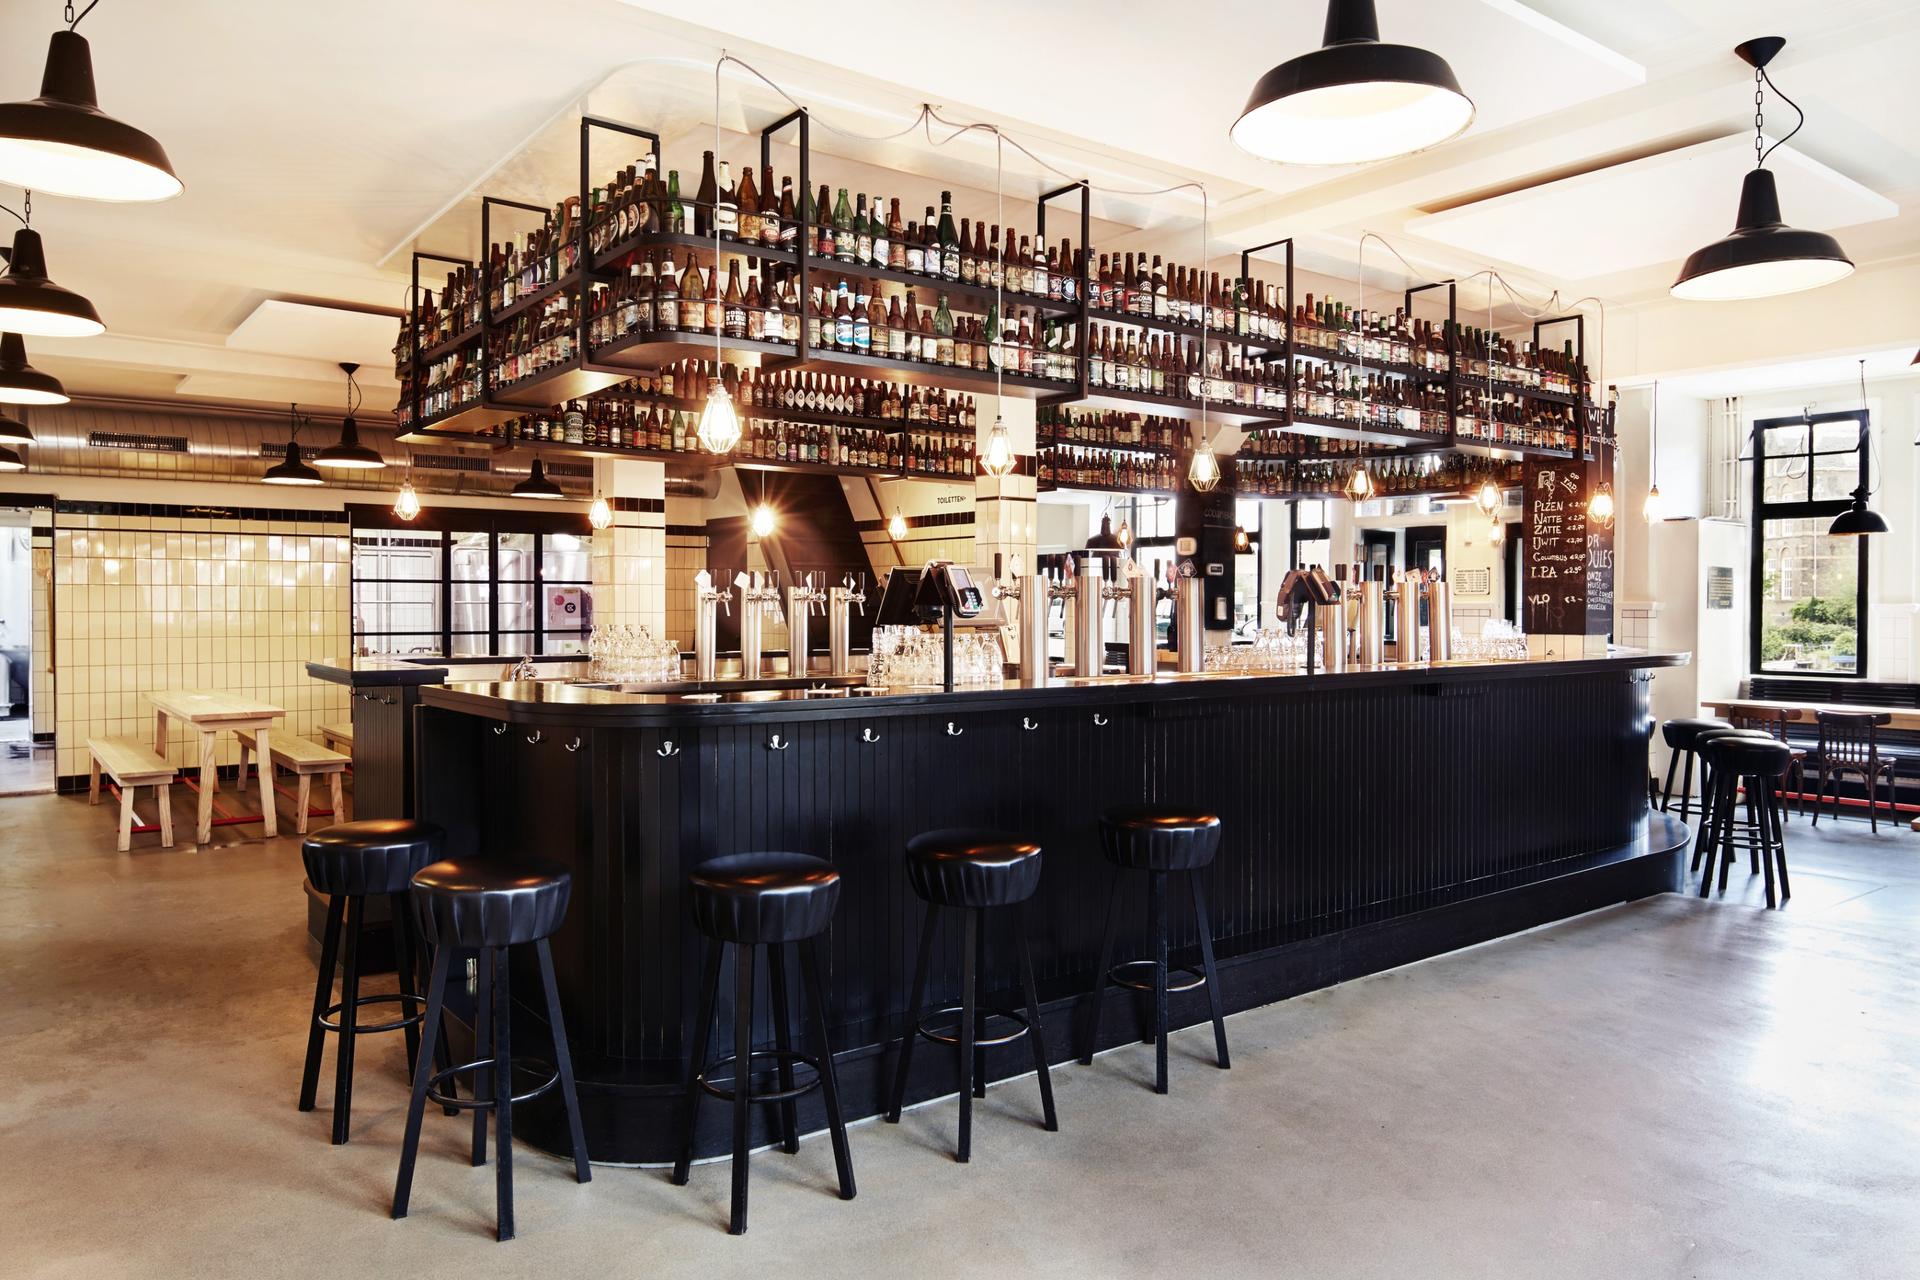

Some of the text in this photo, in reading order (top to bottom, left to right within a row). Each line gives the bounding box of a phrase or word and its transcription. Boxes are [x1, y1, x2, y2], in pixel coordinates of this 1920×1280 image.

[937, 496, 964, 504] TOILETTEN
[1534, 513, 1562, 524] NATTE
[1534, 525, 1562, 534] ZATTE
